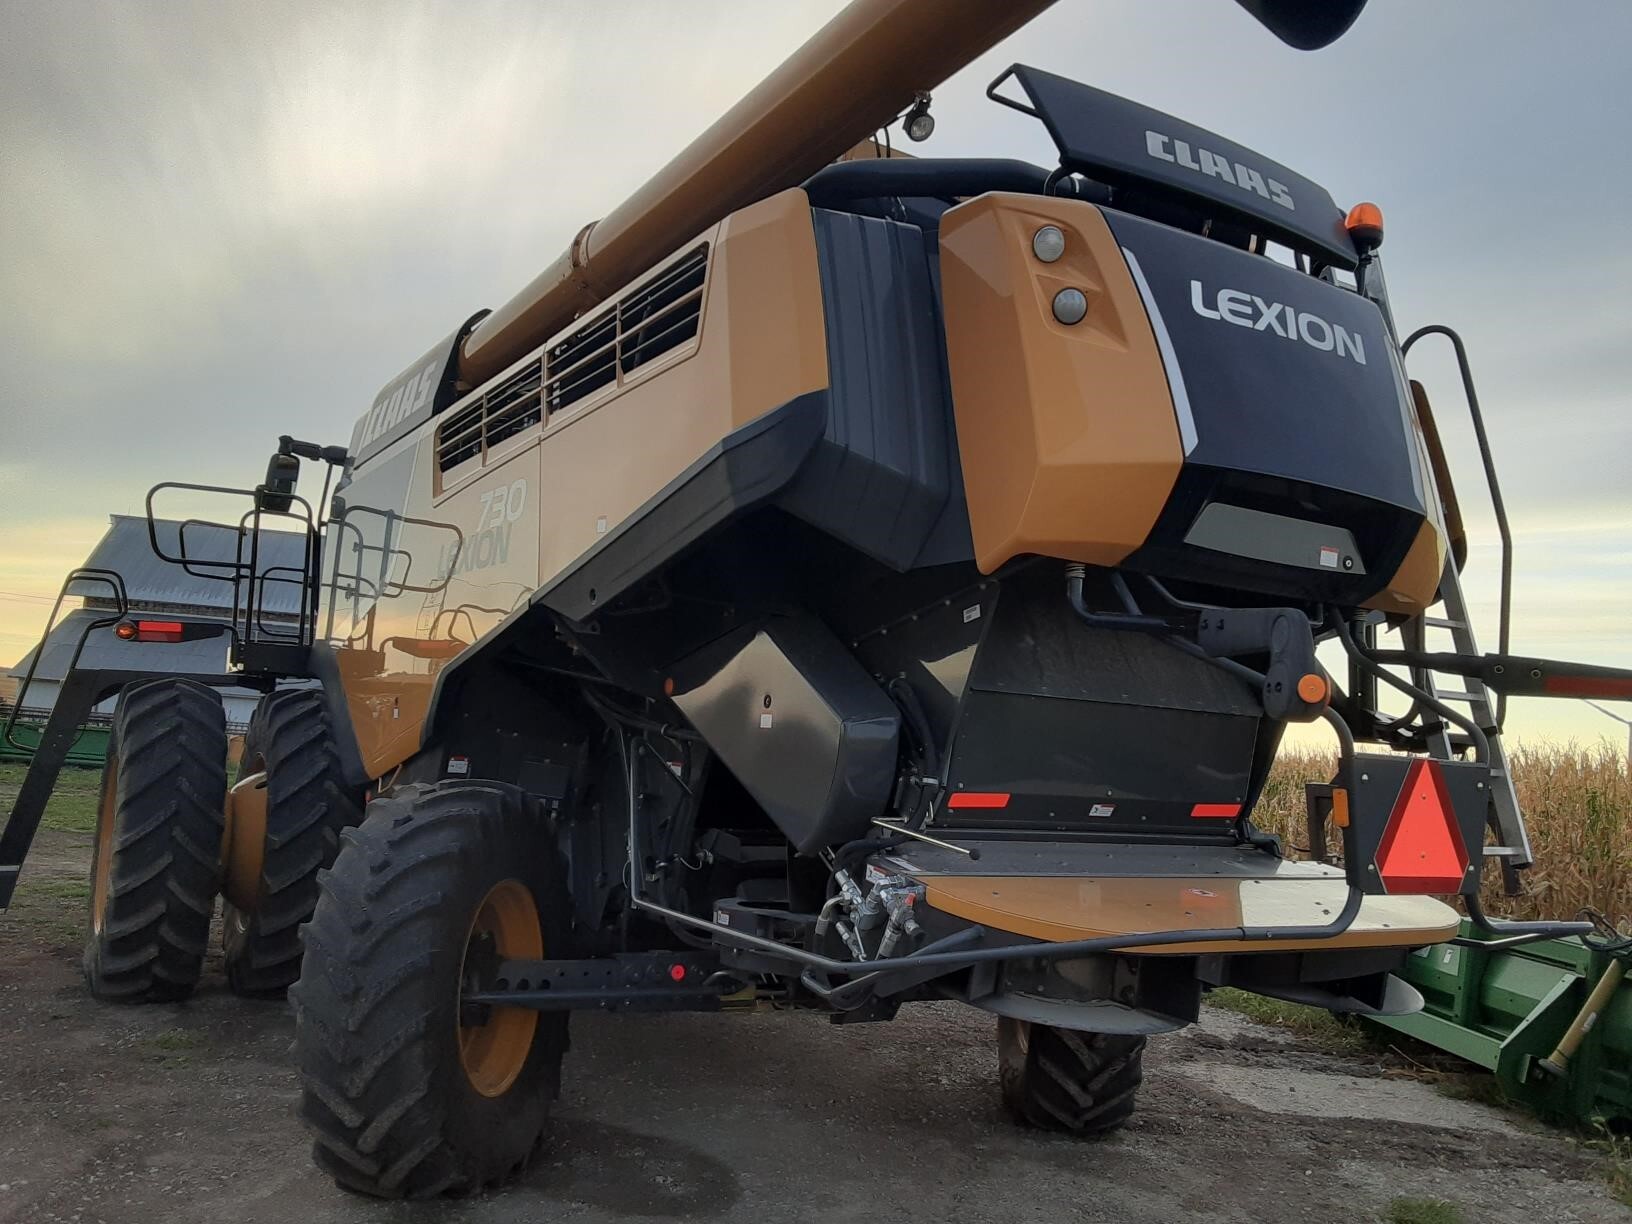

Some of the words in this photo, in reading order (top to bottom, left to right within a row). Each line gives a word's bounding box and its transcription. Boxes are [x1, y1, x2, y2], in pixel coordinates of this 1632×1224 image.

[1145, 130, 1295, 210] CLAAS
[1190, 279, 1367, 365] LEXION
[362, 360, 438, 448] CLAAS
[477, 479, 528, 532] 730
[437, 523, 513, 580] LEXION
